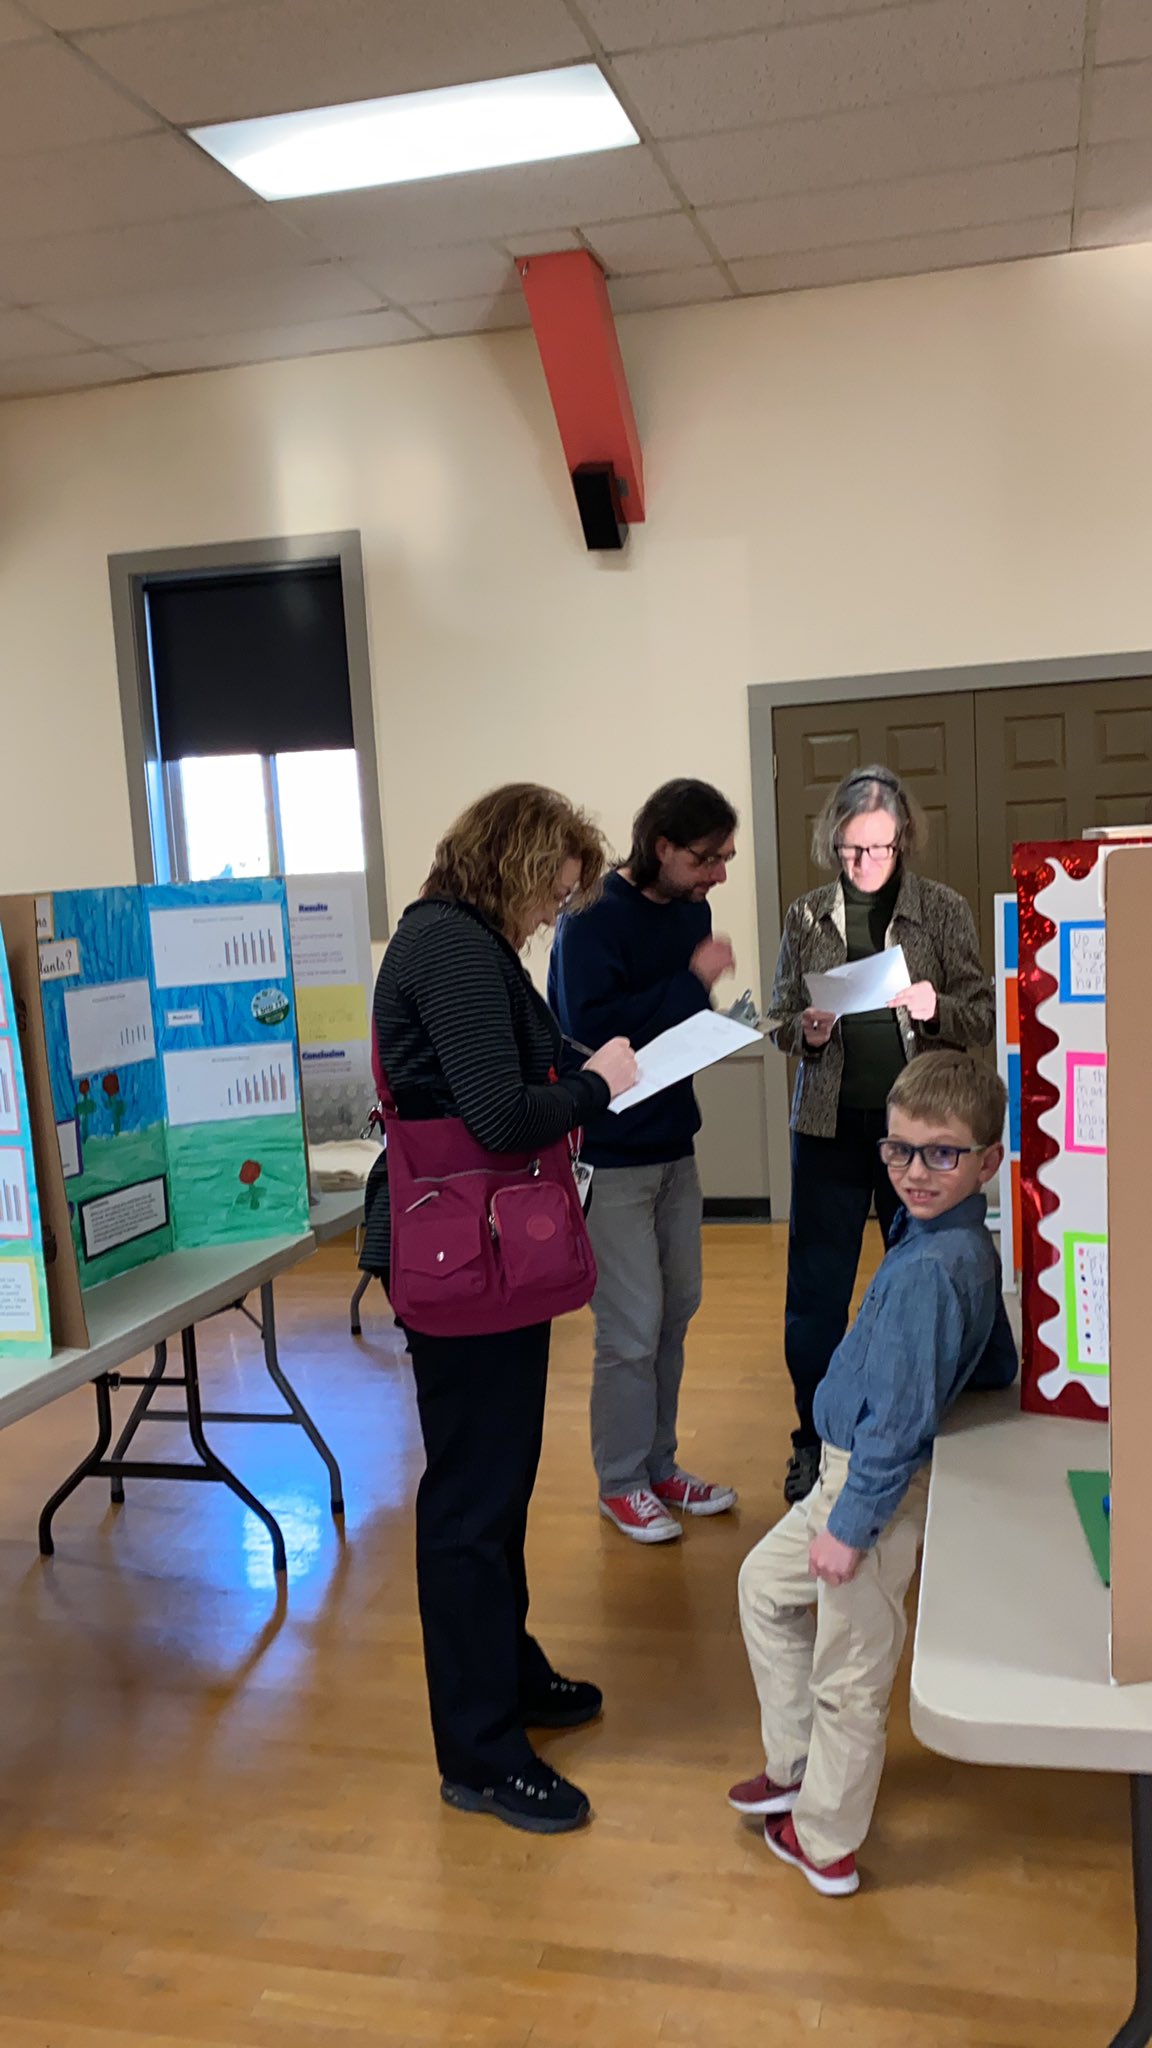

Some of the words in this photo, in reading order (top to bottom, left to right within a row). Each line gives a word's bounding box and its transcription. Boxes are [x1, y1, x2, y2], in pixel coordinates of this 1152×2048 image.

[299, 904, 328, 912] Results
[39, 949, 72, 975] lants?
[302, 1049, 345, 1060] Conclusion
